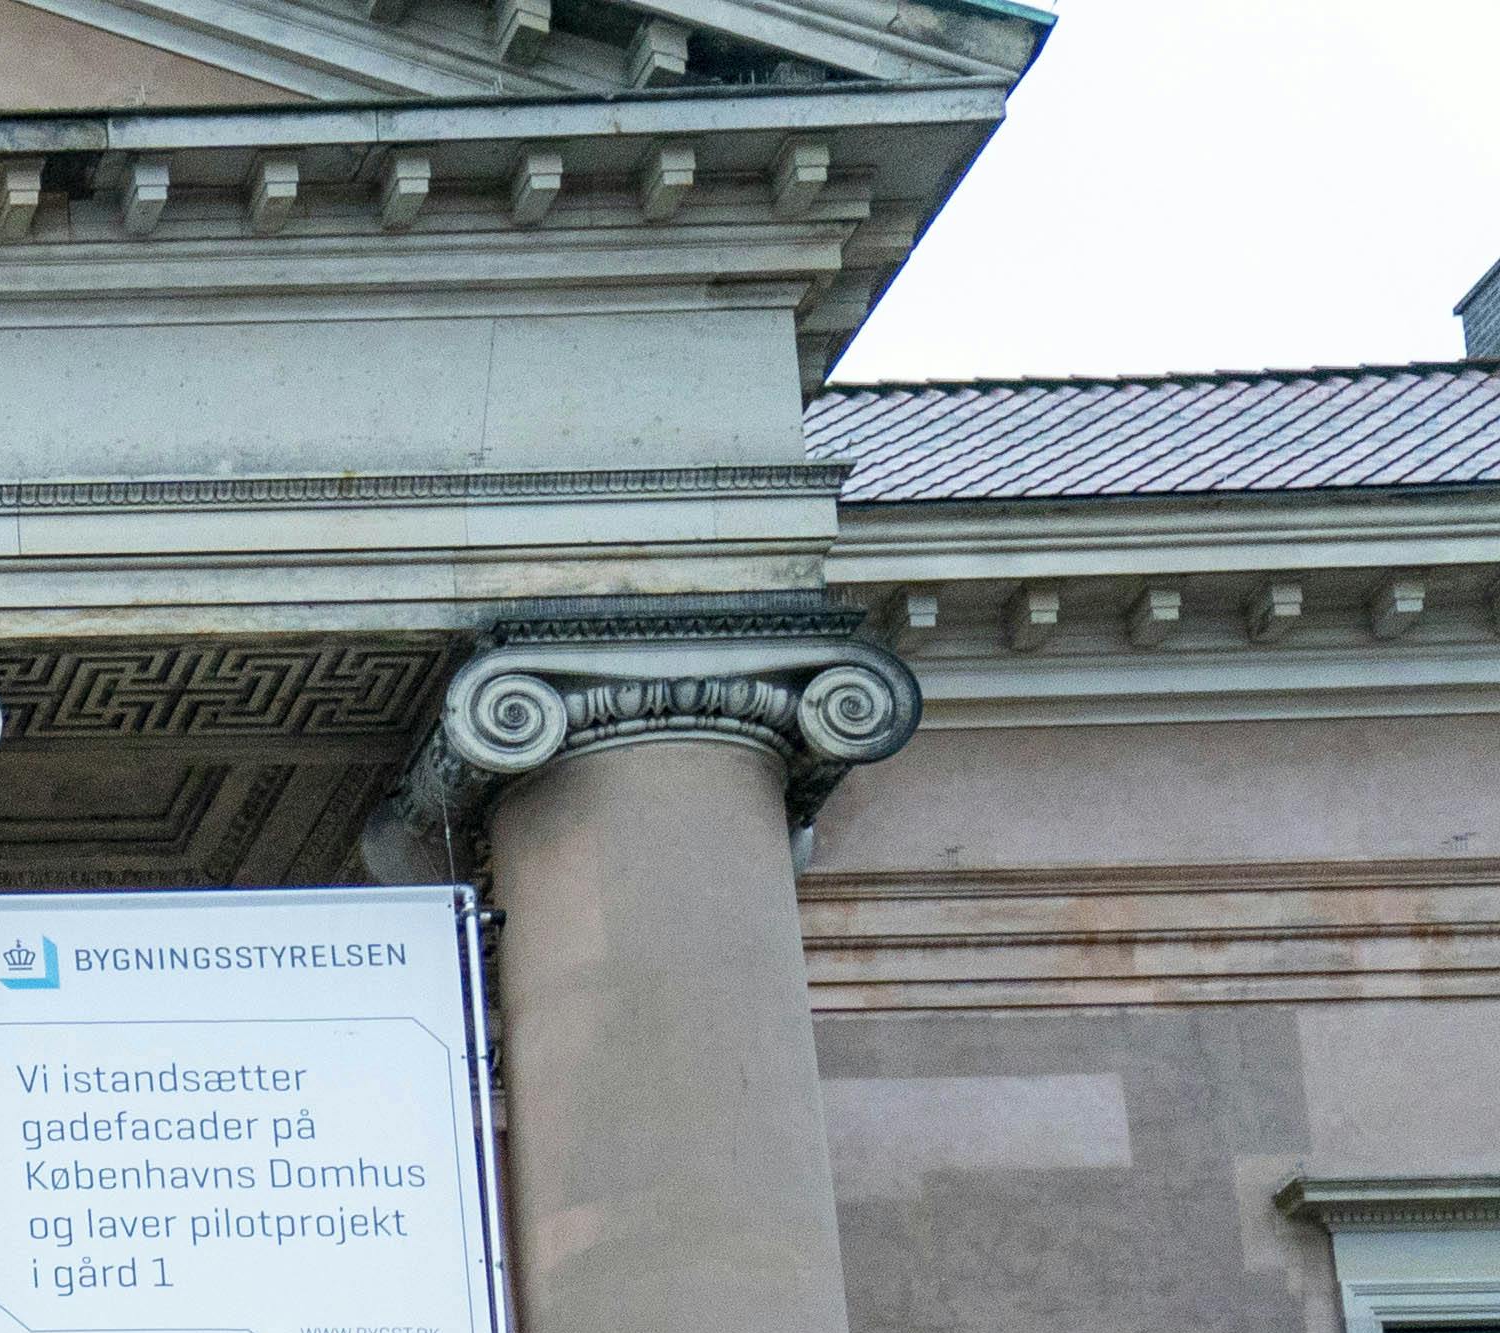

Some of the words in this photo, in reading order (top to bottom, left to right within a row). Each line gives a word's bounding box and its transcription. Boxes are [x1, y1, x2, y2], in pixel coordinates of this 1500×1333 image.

[75, 944, 406, 971] BYGNINGSSTYRELSEN
[17, 1064, 48, 1093] Vi
[63, 1063, 306, 1093] istandsætter
[23, 1111, 258, 1150] gadefacader
[273, 1109, 315, 1147] på
[26, 1160, 255, 1190] Københavns
[270, 1158, 425, 1188] Domhus
[30, 1217, 72, 1247] og
[88, 1209, 176, 1238] laver
[191, 1206, 407, 1246] pilotprojekt
[33, 1259, 38, 1288] i
[54, 1257, 137, 1296] gård
[153, 1258, 173, 1286] 1
